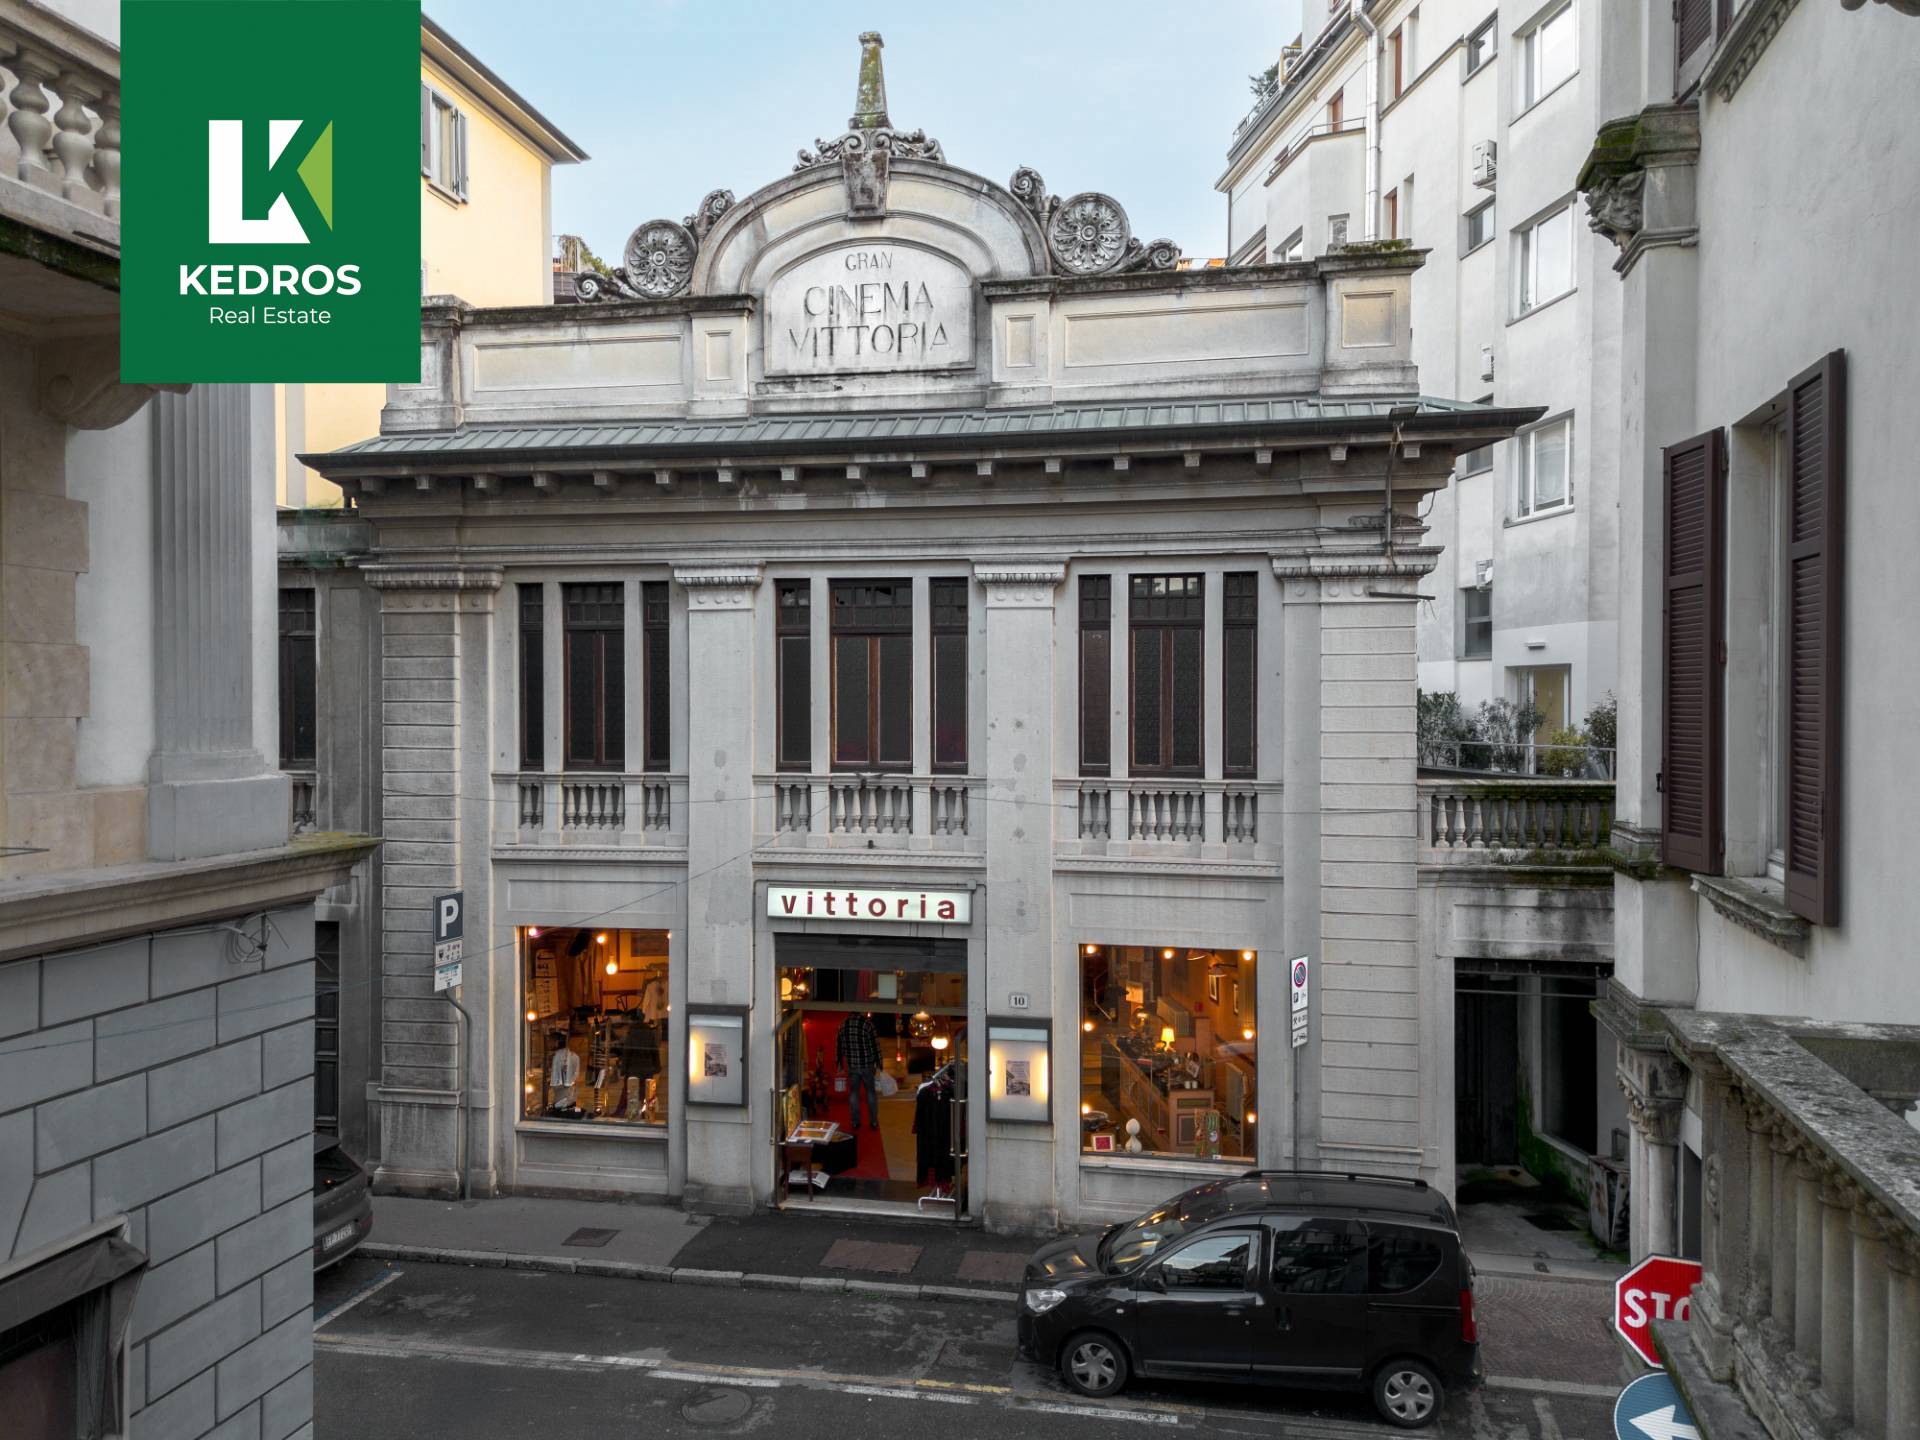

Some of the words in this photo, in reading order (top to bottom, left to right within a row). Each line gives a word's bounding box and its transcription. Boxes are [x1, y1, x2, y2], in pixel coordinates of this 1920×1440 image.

[845, 251, 893, 271] GRAN
[804, 281, 933, 316] CINEMA
[788, 321, 949, 356] VITTORIA
[441, 898, 459, 938] P
[781, 891, 955, 920] vittoria
[1014, 996, 1025, 1006] 10
[1623, 1288, 1692, 1329] STO
